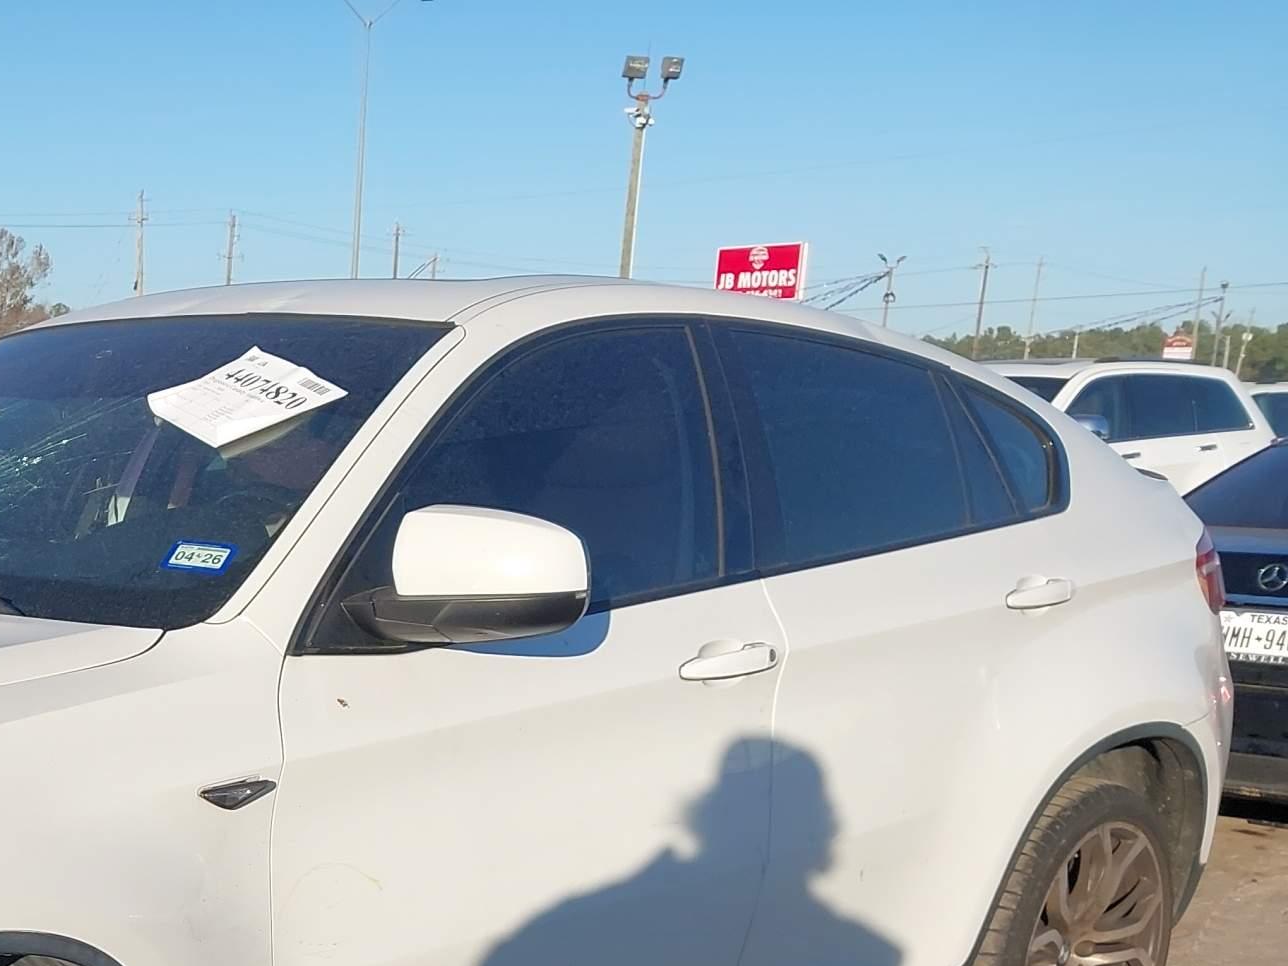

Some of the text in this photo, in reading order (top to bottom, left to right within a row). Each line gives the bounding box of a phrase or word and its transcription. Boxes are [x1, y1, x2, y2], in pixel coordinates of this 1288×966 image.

[717, 269, 797, 290] JB MOTORS
[224, 368, 308, 410] 44074820
[174, 550, 224, 565] 04 26
[1250, 613, 1288, 626] TEXAS
